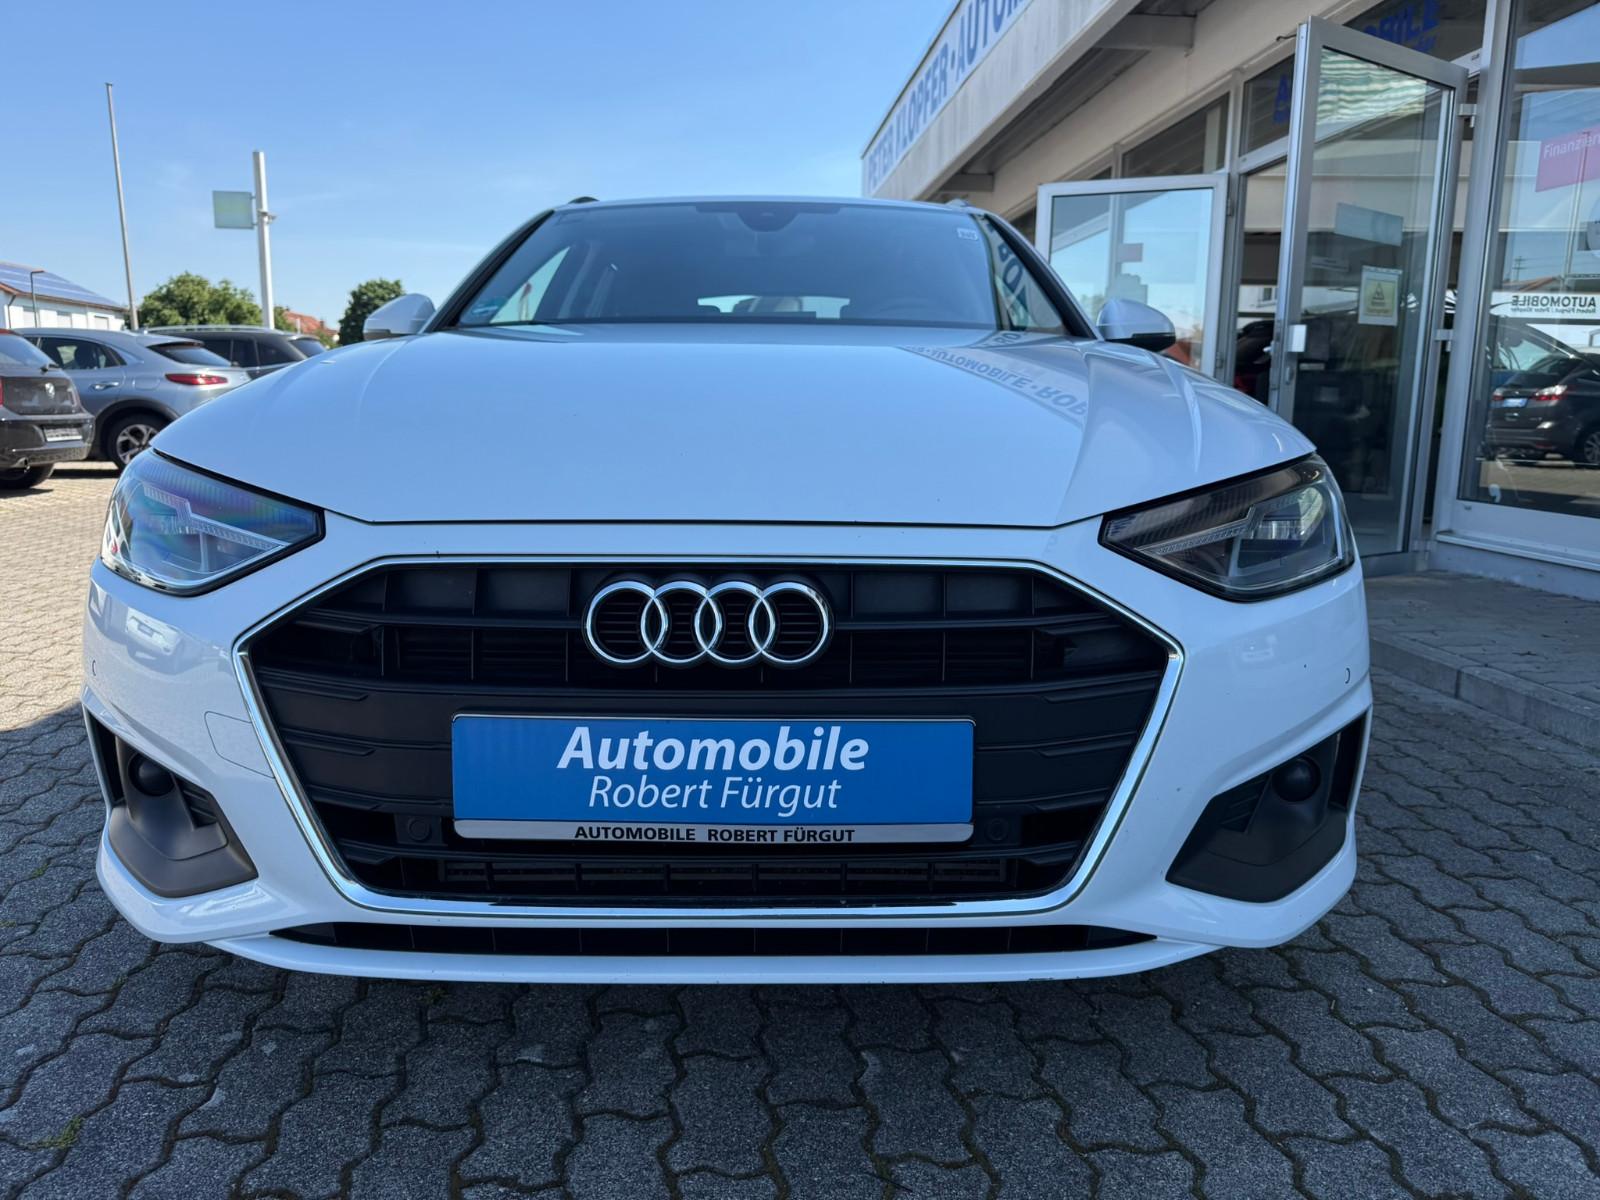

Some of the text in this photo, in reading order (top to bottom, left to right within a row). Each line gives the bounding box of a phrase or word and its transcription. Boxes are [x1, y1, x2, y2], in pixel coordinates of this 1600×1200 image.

[956, 0, 1022, 83] AUTO
[556, 726, 869, 771] Automobile
[589, 775, 842, 817] Robert Fürgut
[575, 826, 856, 842] AUTOMOBILE ROBERT FÜRGUT
